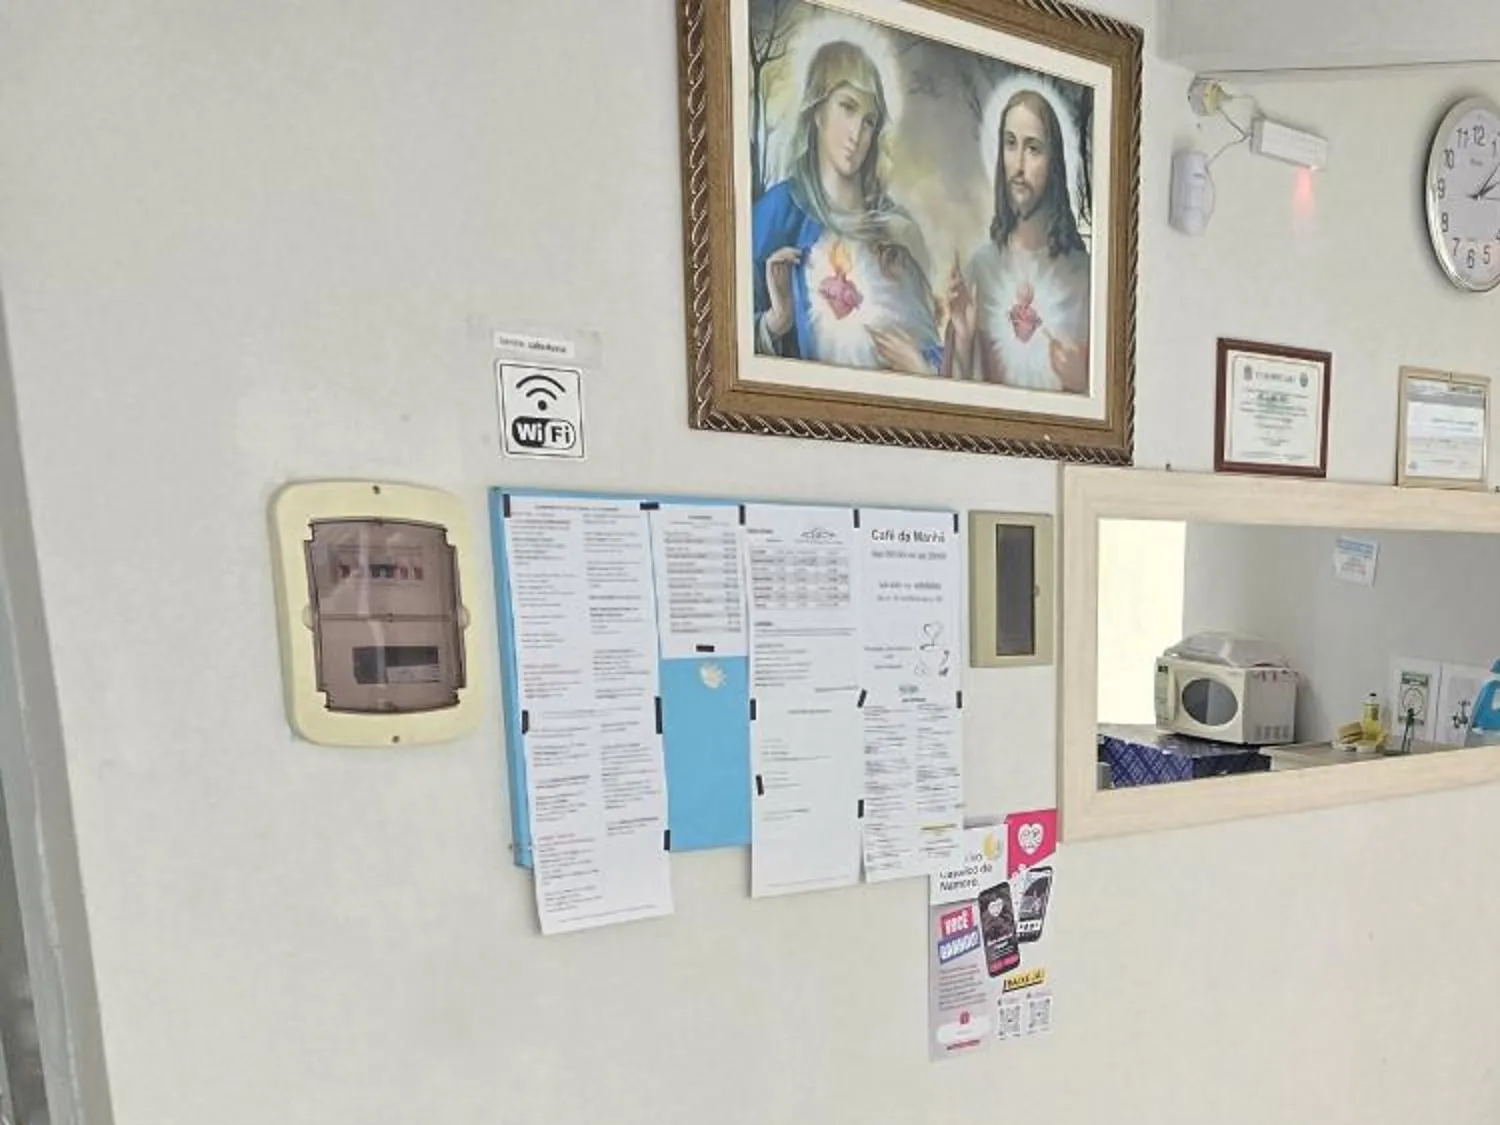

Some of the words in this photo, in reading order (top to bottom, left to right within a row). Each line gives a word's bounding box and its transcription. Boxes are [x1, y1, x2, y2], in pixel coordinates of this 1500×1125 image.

[1456, 128, 1469, 149] 11
[1472, 125, 1485, 146] 12
[1444, 149, 1455, 169] 10
[1437, 178, 1446, 199] 9
[1441, 212, 1449, 233] 8
[1452, 237, 1460, 258] 7
[1482, 244, 1491, 265] 5
[1466, 248, 1475, 270] 6
[871, 529, 894, 541] Café
[898, 530, 910, 543] da
[914, 530, 945, 543] Manhã
